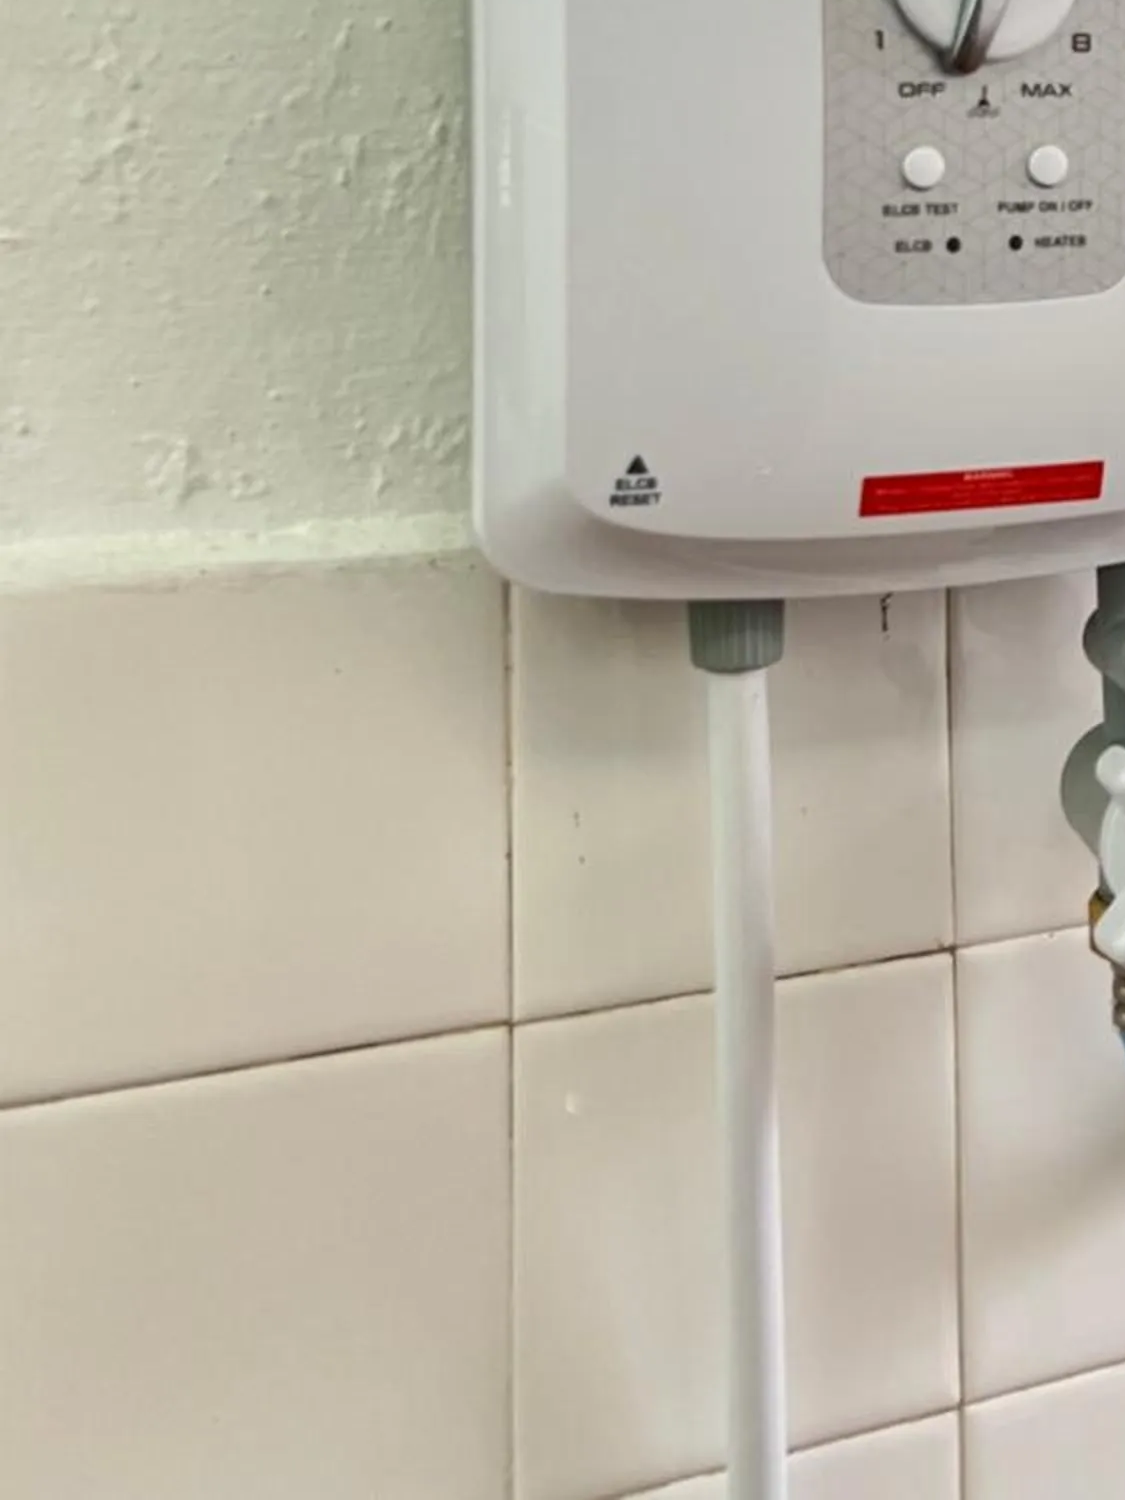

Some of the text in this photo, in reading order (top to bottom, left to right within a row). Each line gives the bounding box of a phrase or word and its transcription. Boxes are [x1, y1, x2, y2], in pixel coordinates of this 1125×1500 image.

[875, 30, 884, 50] 1
[1072, 33, 1091, 53] 8
[898, 81, 946, 98] OFF
[1020, 83, 1072, 98] MAX
[882, 202, 959, 217] ELCB TEST
[997, 201, 1034, 213] PUMP
[1039, 201, 1058, 212] ON
[1069, 200, 1093, 211] OFF
[895, 239, 932, 253] ELCB
[1034, 235, 1087, 248] HEATER
[615, 478, 658, 491] ELCB
[609, 492, 662, 507] RESET
